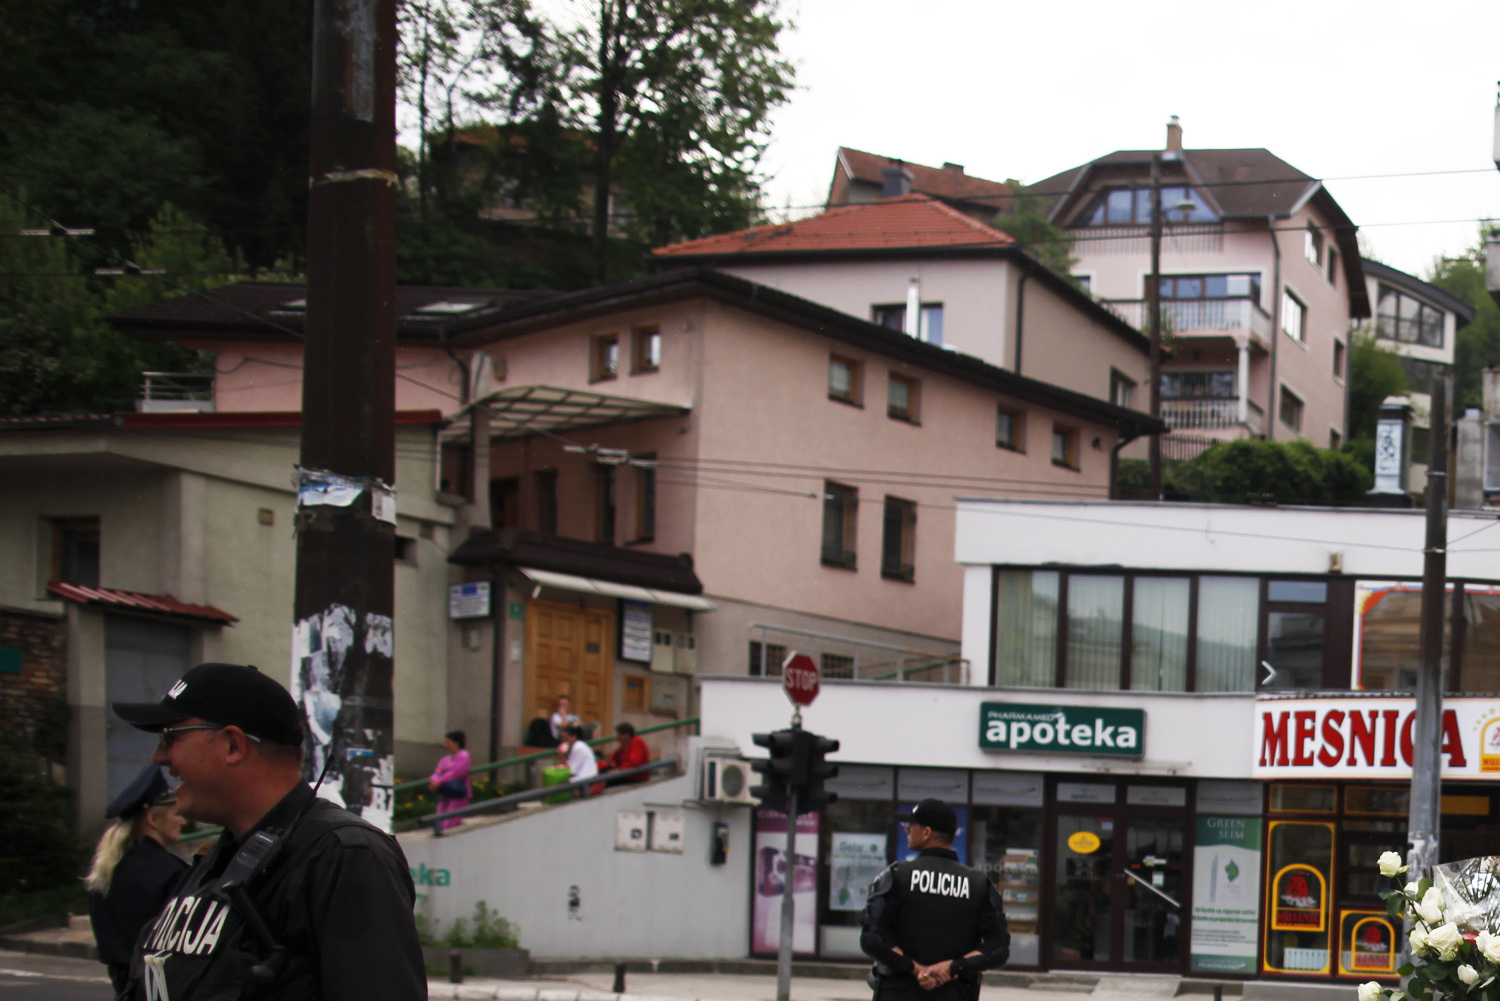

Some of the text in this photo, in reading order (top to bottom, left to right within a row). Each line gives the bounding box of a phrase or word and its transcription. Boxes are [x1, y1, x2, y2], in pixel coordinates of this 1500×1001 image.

[786, 668, 816, 691] STOP
[986, 713, 1137, 749] apoteka
[1207, 817, 1246, 830] GREEN
[1218, 829, 1245, 840] SLIM
[910, 870, 970, 899] POLICIJA
